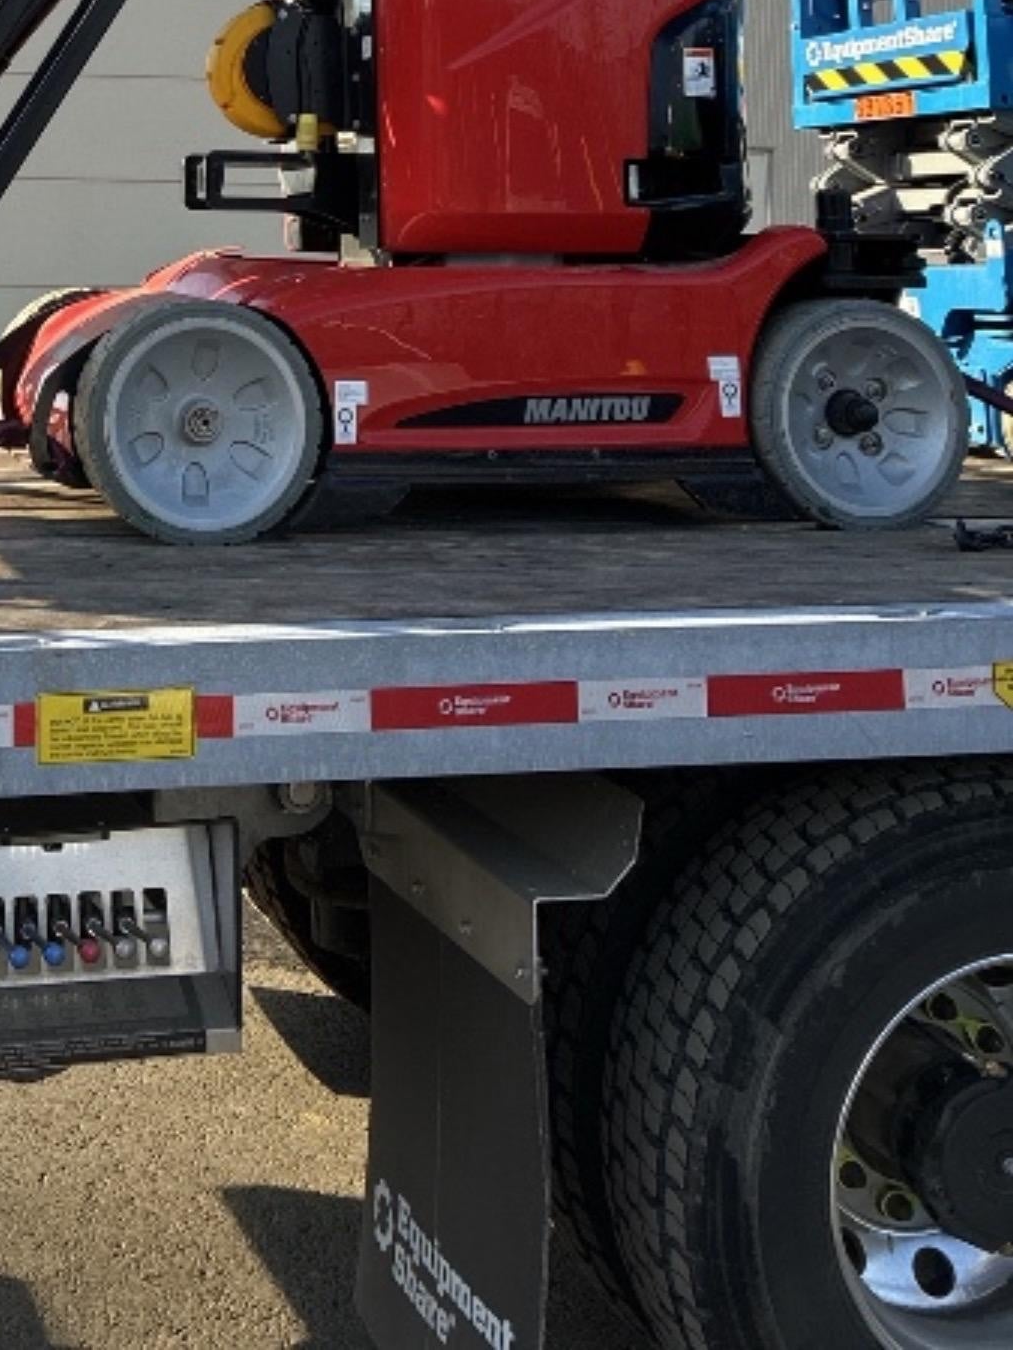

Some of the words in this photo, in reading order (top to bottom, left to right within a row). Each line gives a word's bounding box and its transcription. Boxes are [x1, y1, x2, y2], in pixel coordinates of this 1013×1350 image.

[822, 23, 956, 64] EquipmentShare
[524, 396, 651, 424] MANITOU
[391, 1241, 449, 1345] Share
[397, 1193, 516, 1350] Equipment
